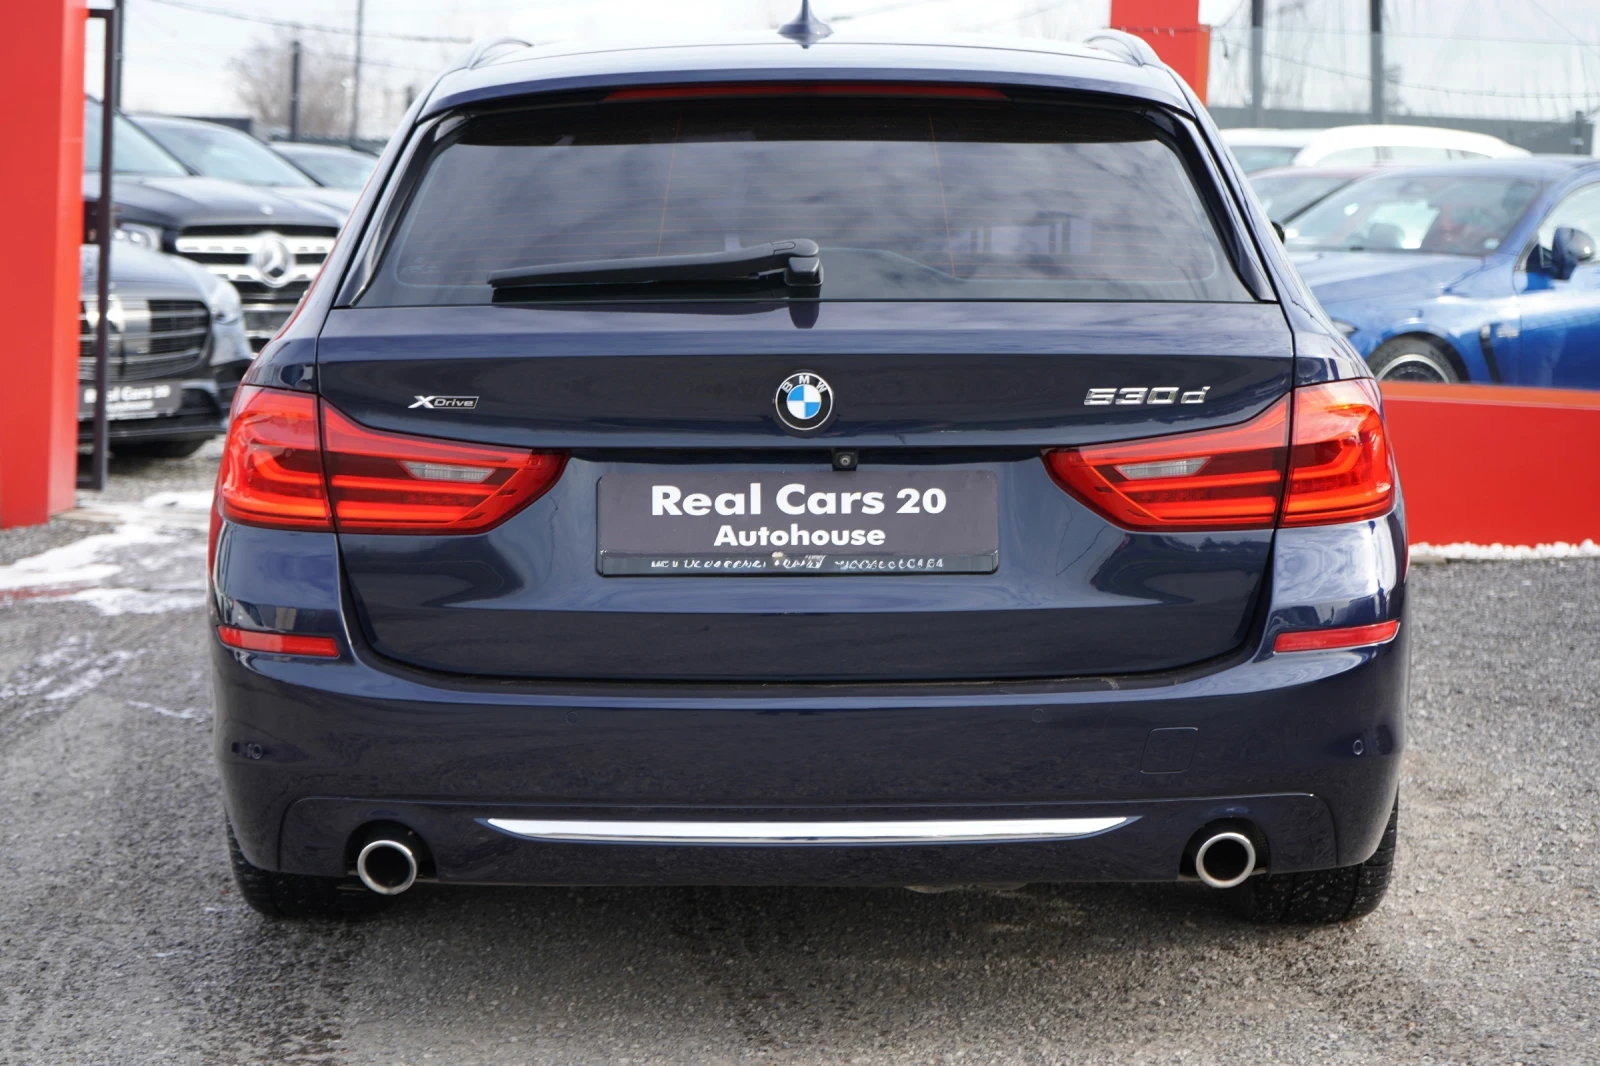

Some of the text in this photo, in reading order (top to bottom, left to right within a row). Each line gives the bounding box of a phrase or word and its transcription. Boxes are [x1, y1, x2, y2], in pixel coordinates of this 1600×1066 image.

[781, 375, 828, 394] BMW
[1083, 386, 1211, 406] 530d
[651, 483, 947, 516] Real Cars 20
[713, 524, 886, 547] Autohouse
